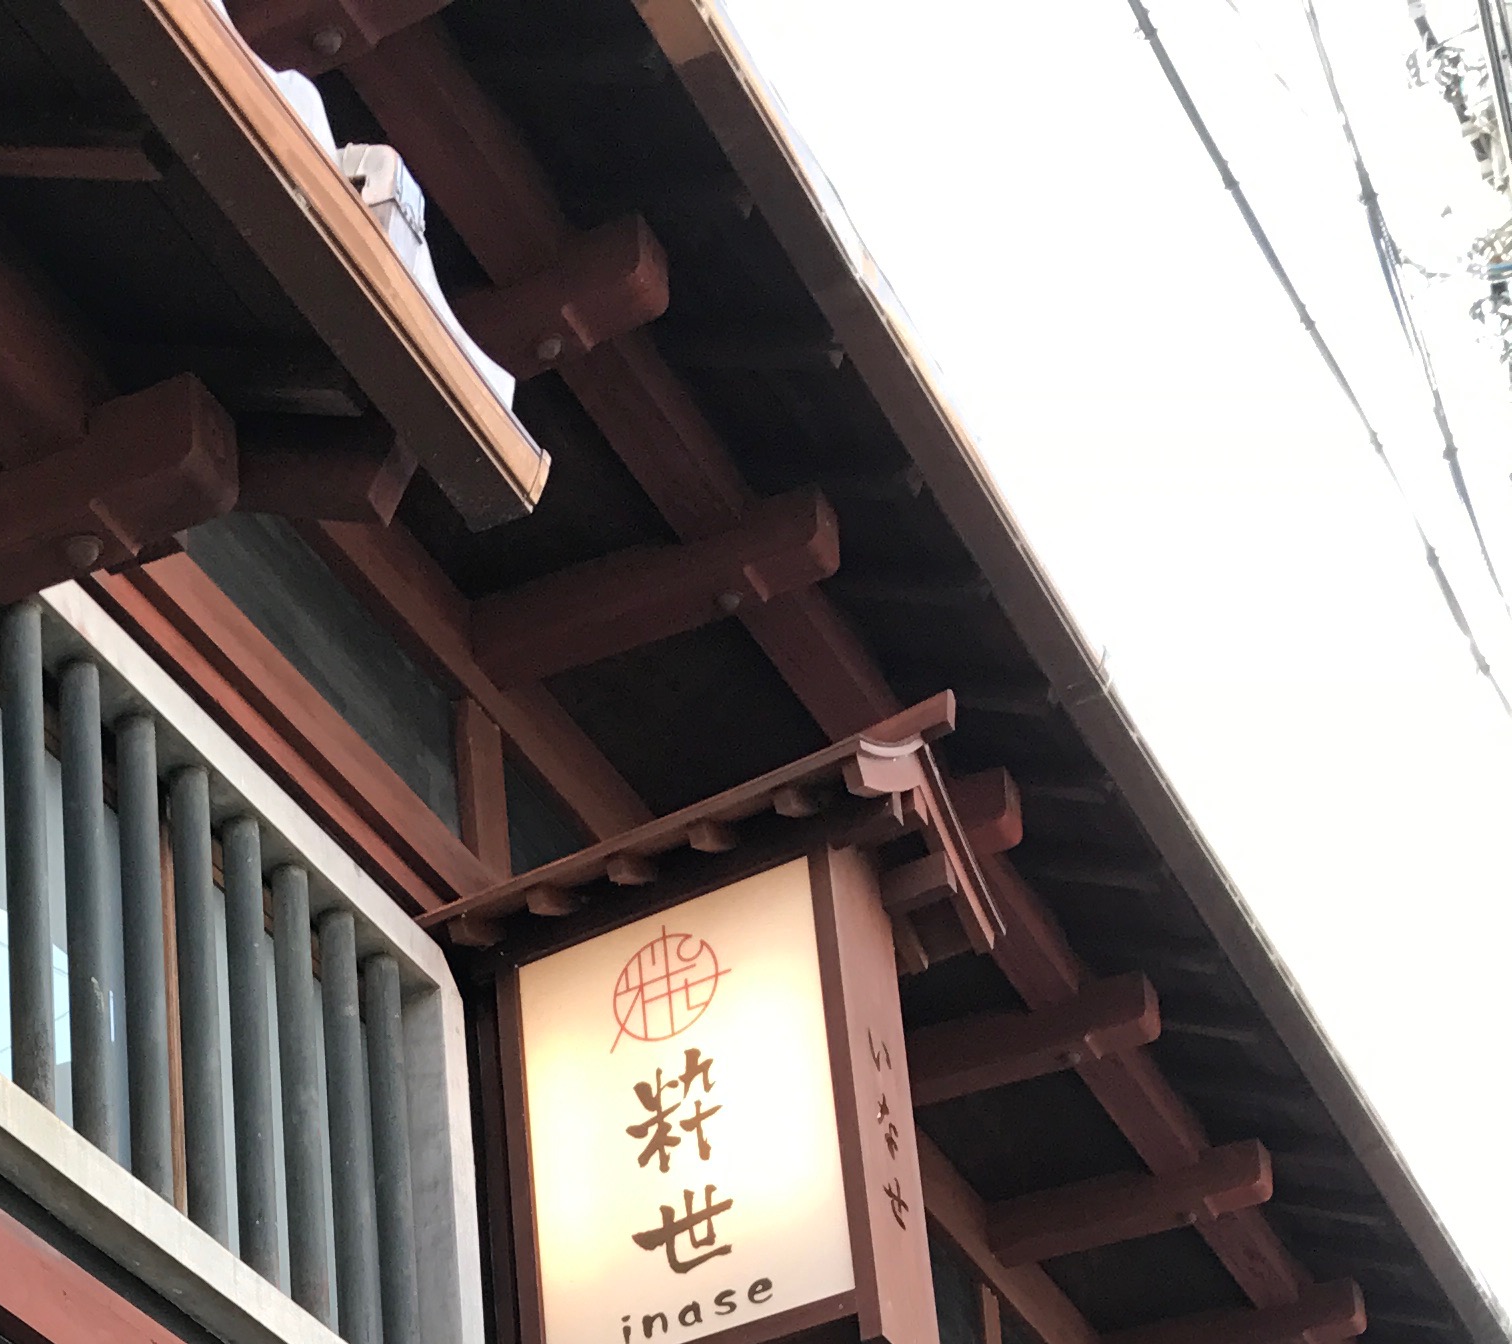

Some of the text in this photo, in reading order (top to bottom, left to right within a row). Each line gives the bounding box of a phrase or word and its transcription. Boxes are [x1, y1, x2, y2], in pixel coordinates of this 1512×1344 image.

[625, 1048, 734, 1274] 粋世
[866, 1026, 909, 1231] いなせ
